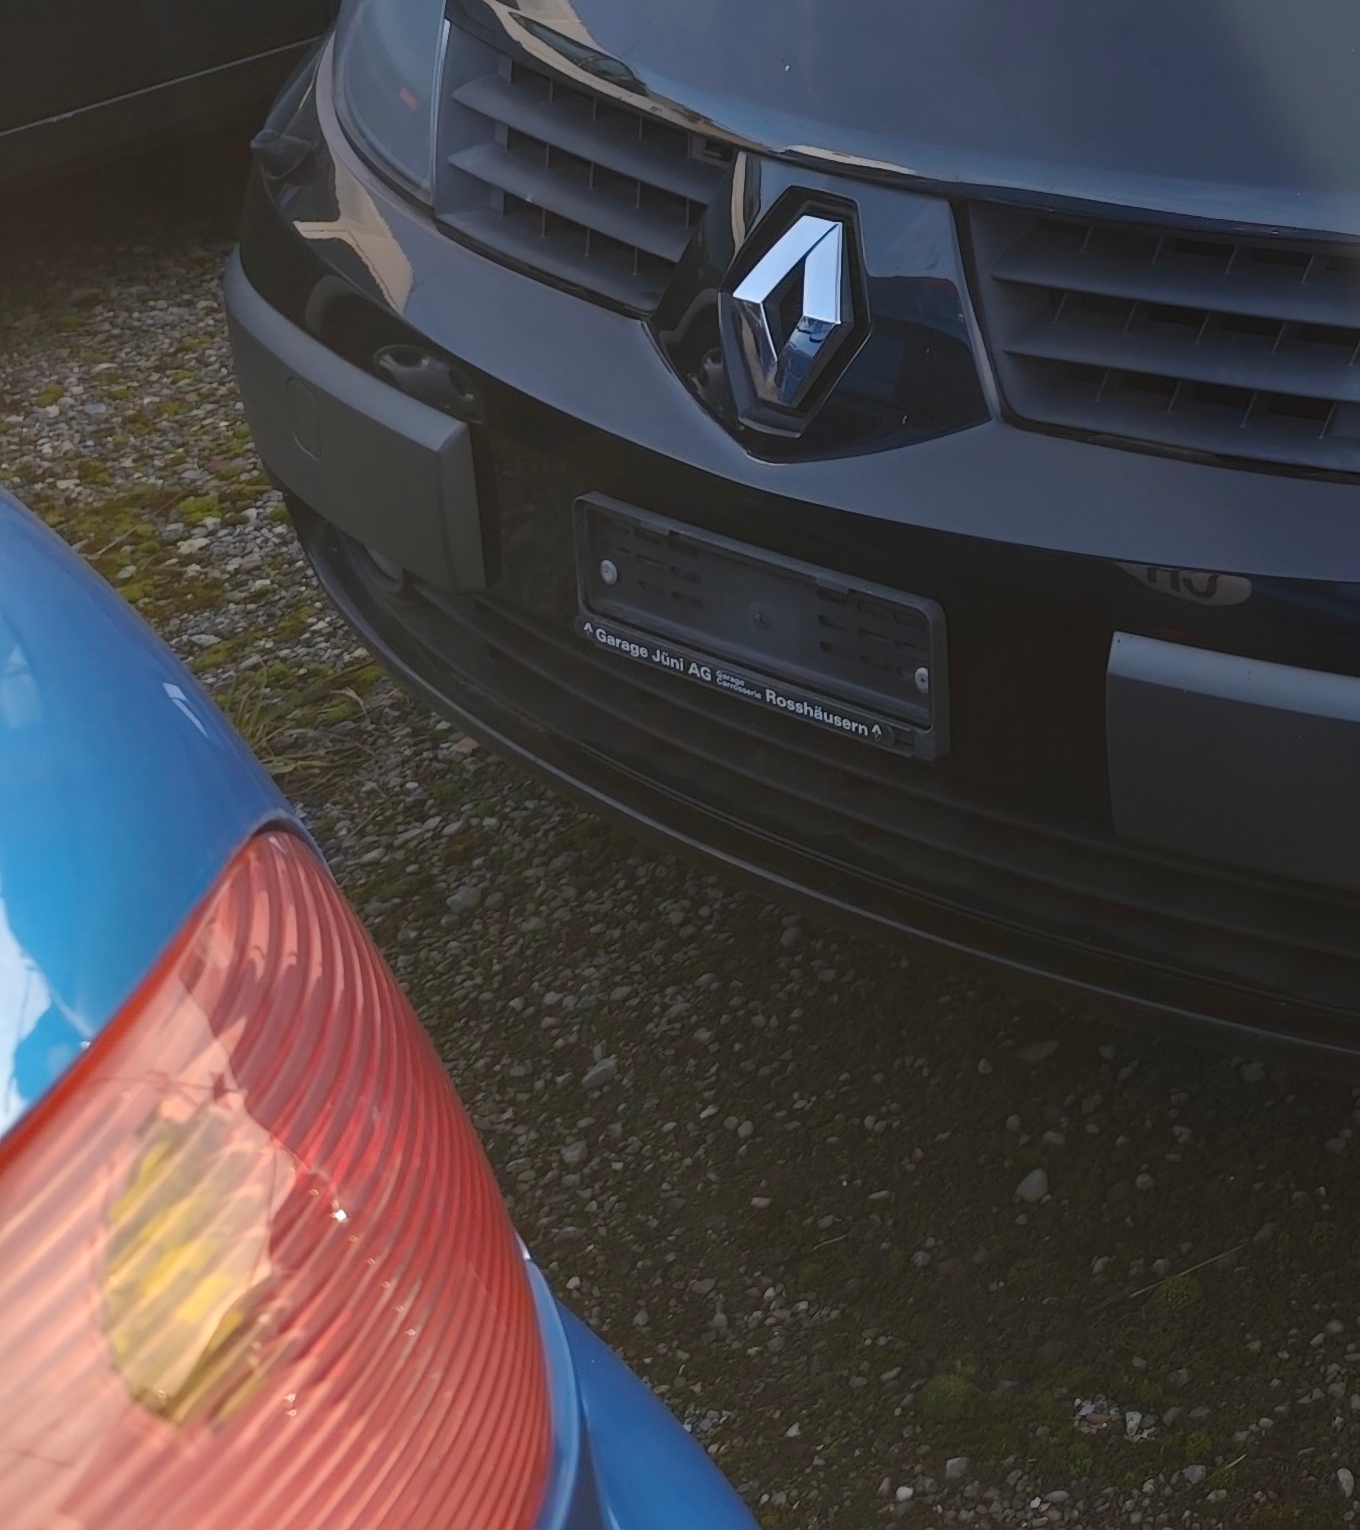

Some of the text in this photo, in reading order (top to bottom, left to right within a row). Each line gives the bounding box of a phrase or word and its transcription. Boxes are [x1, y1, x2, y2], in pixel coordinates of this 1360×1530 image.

[595, 628, 869, 737] Garage Jüni AG Rosshäusern
